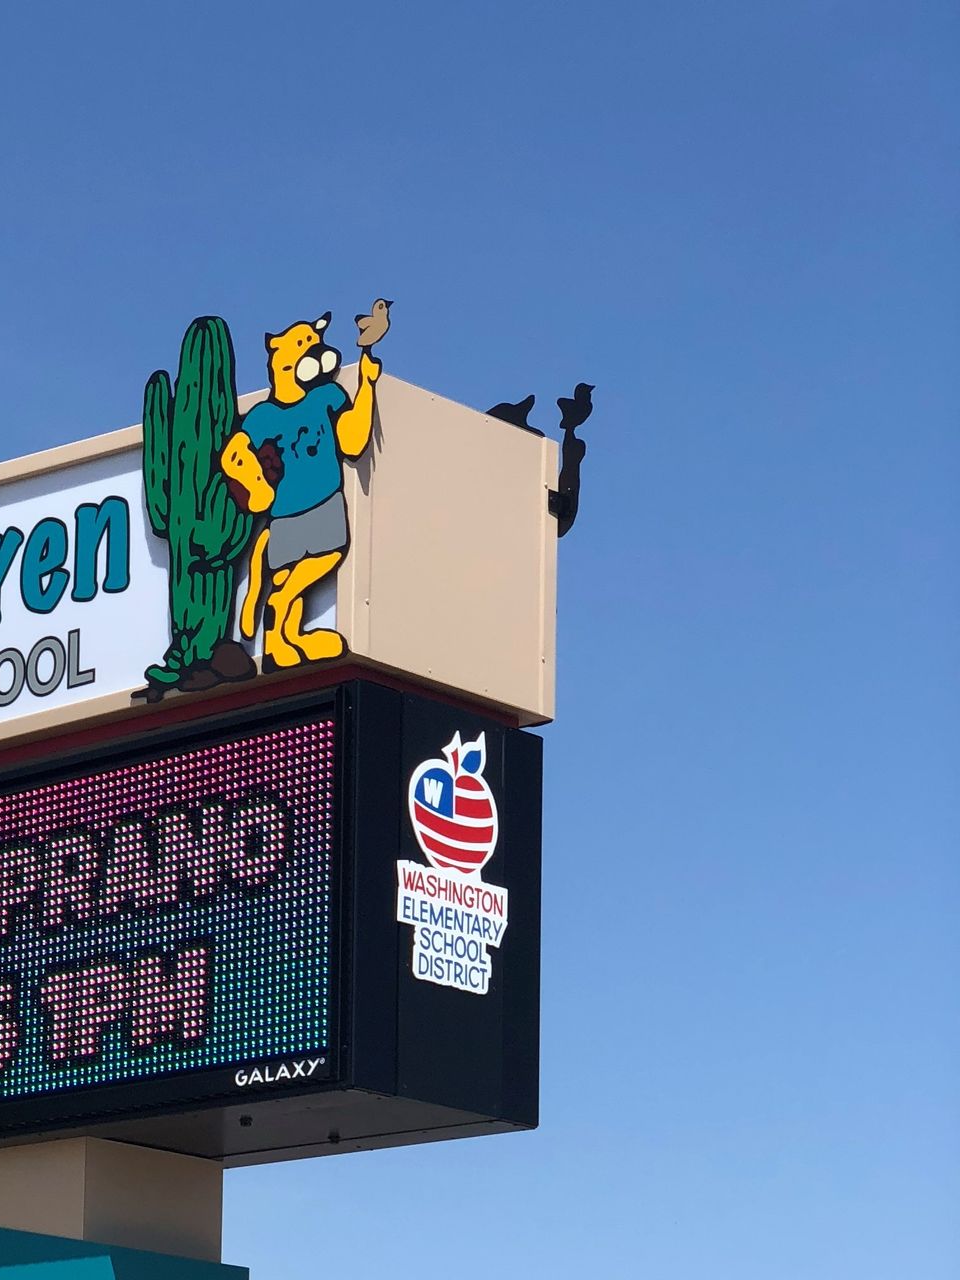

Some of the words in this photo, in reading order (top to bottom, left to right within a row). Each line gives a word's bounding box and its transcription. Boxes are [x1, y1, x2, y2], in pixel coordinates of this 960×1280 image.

[423, 777, 444, 809] W
[402, 867, 504, 918] WASHINGTON
[402, 896, 503, 942] ELEMENTARY
[419, 927, 487, 965] SCHOOL
[418, 952, 488, 990] DISTRICT
[40, 945, 210, 1062] 1PM
